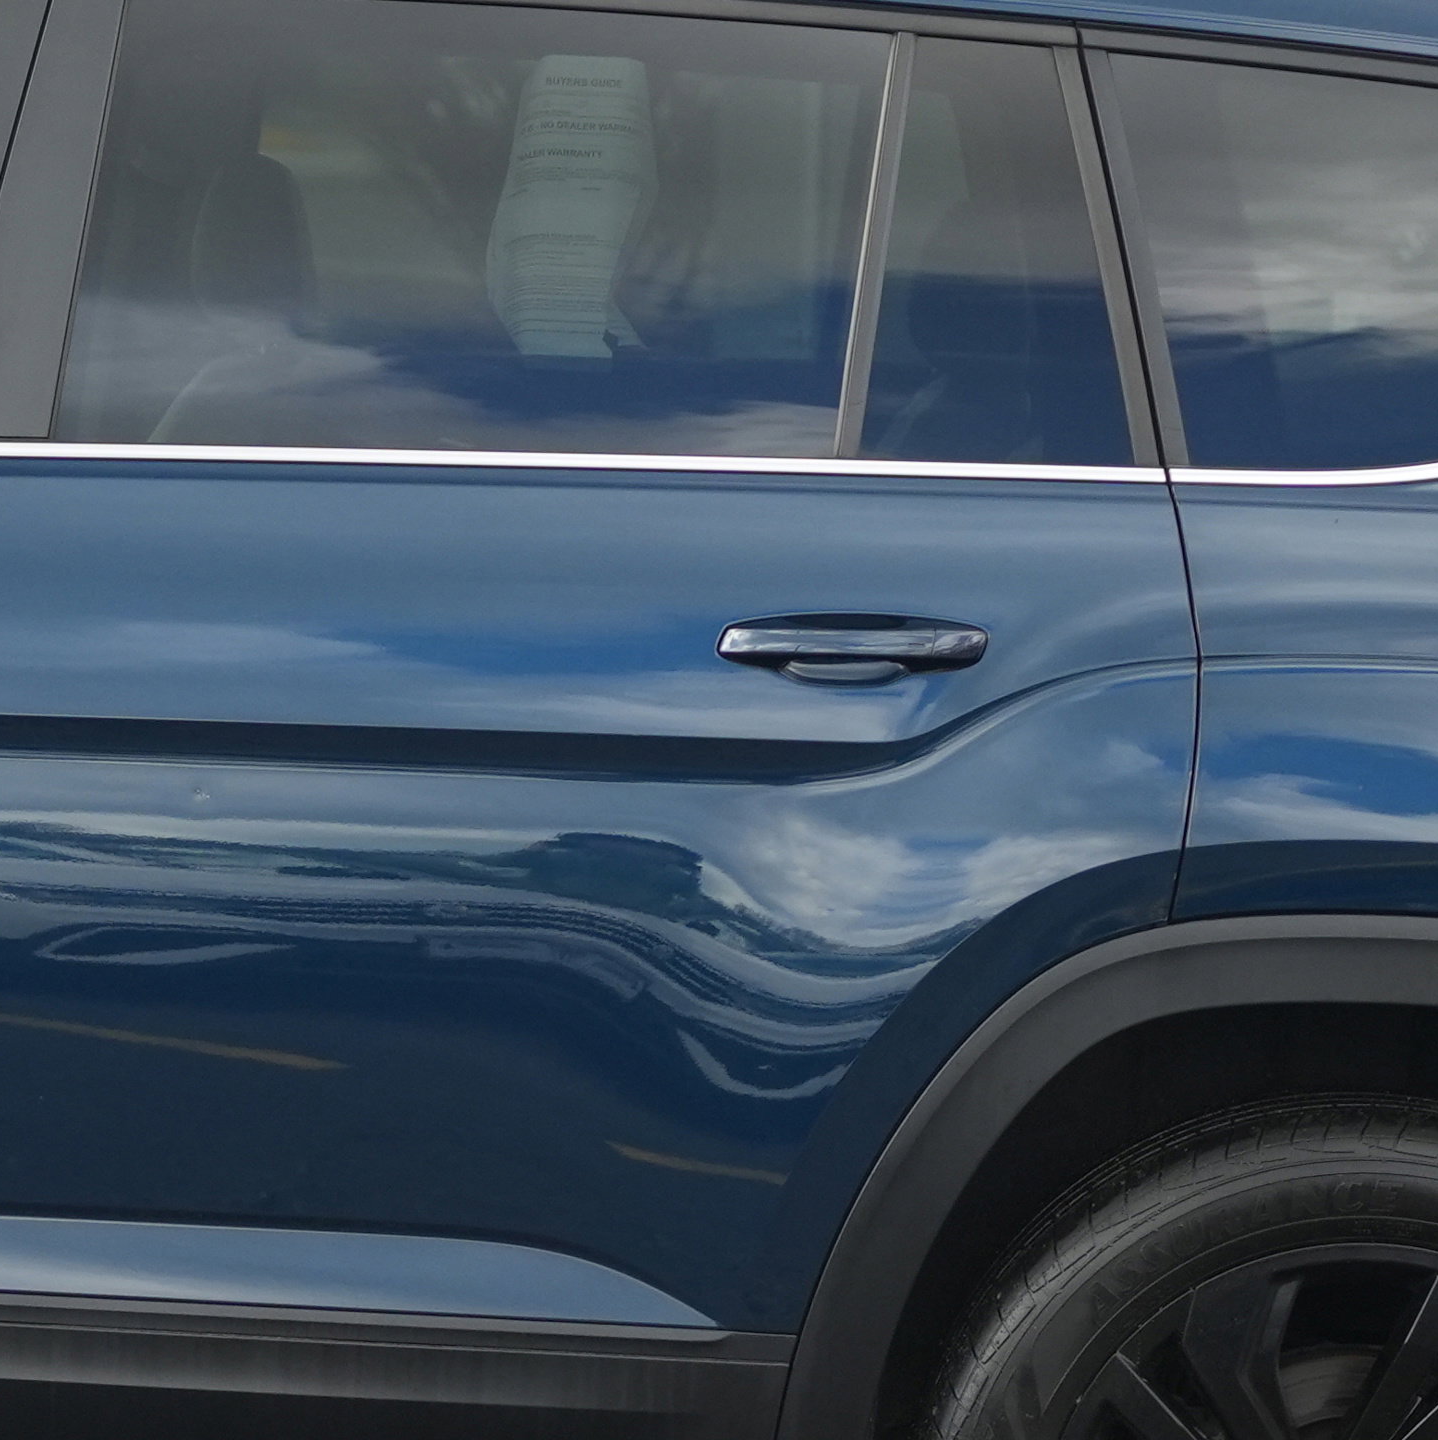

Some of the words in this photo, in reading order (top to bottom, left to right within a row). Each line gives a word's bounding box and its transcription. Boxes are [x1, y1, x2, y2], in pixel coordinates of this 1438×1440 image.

[545, 76, 589, 88] BUYERS
[590, 78, 624, 89] GUIDE
[556, 121, 597, 131] DEALER
[547, 148, 604, 160] WARRANTY
[1090, 1179, 1406, 1322] ASSURANCE
